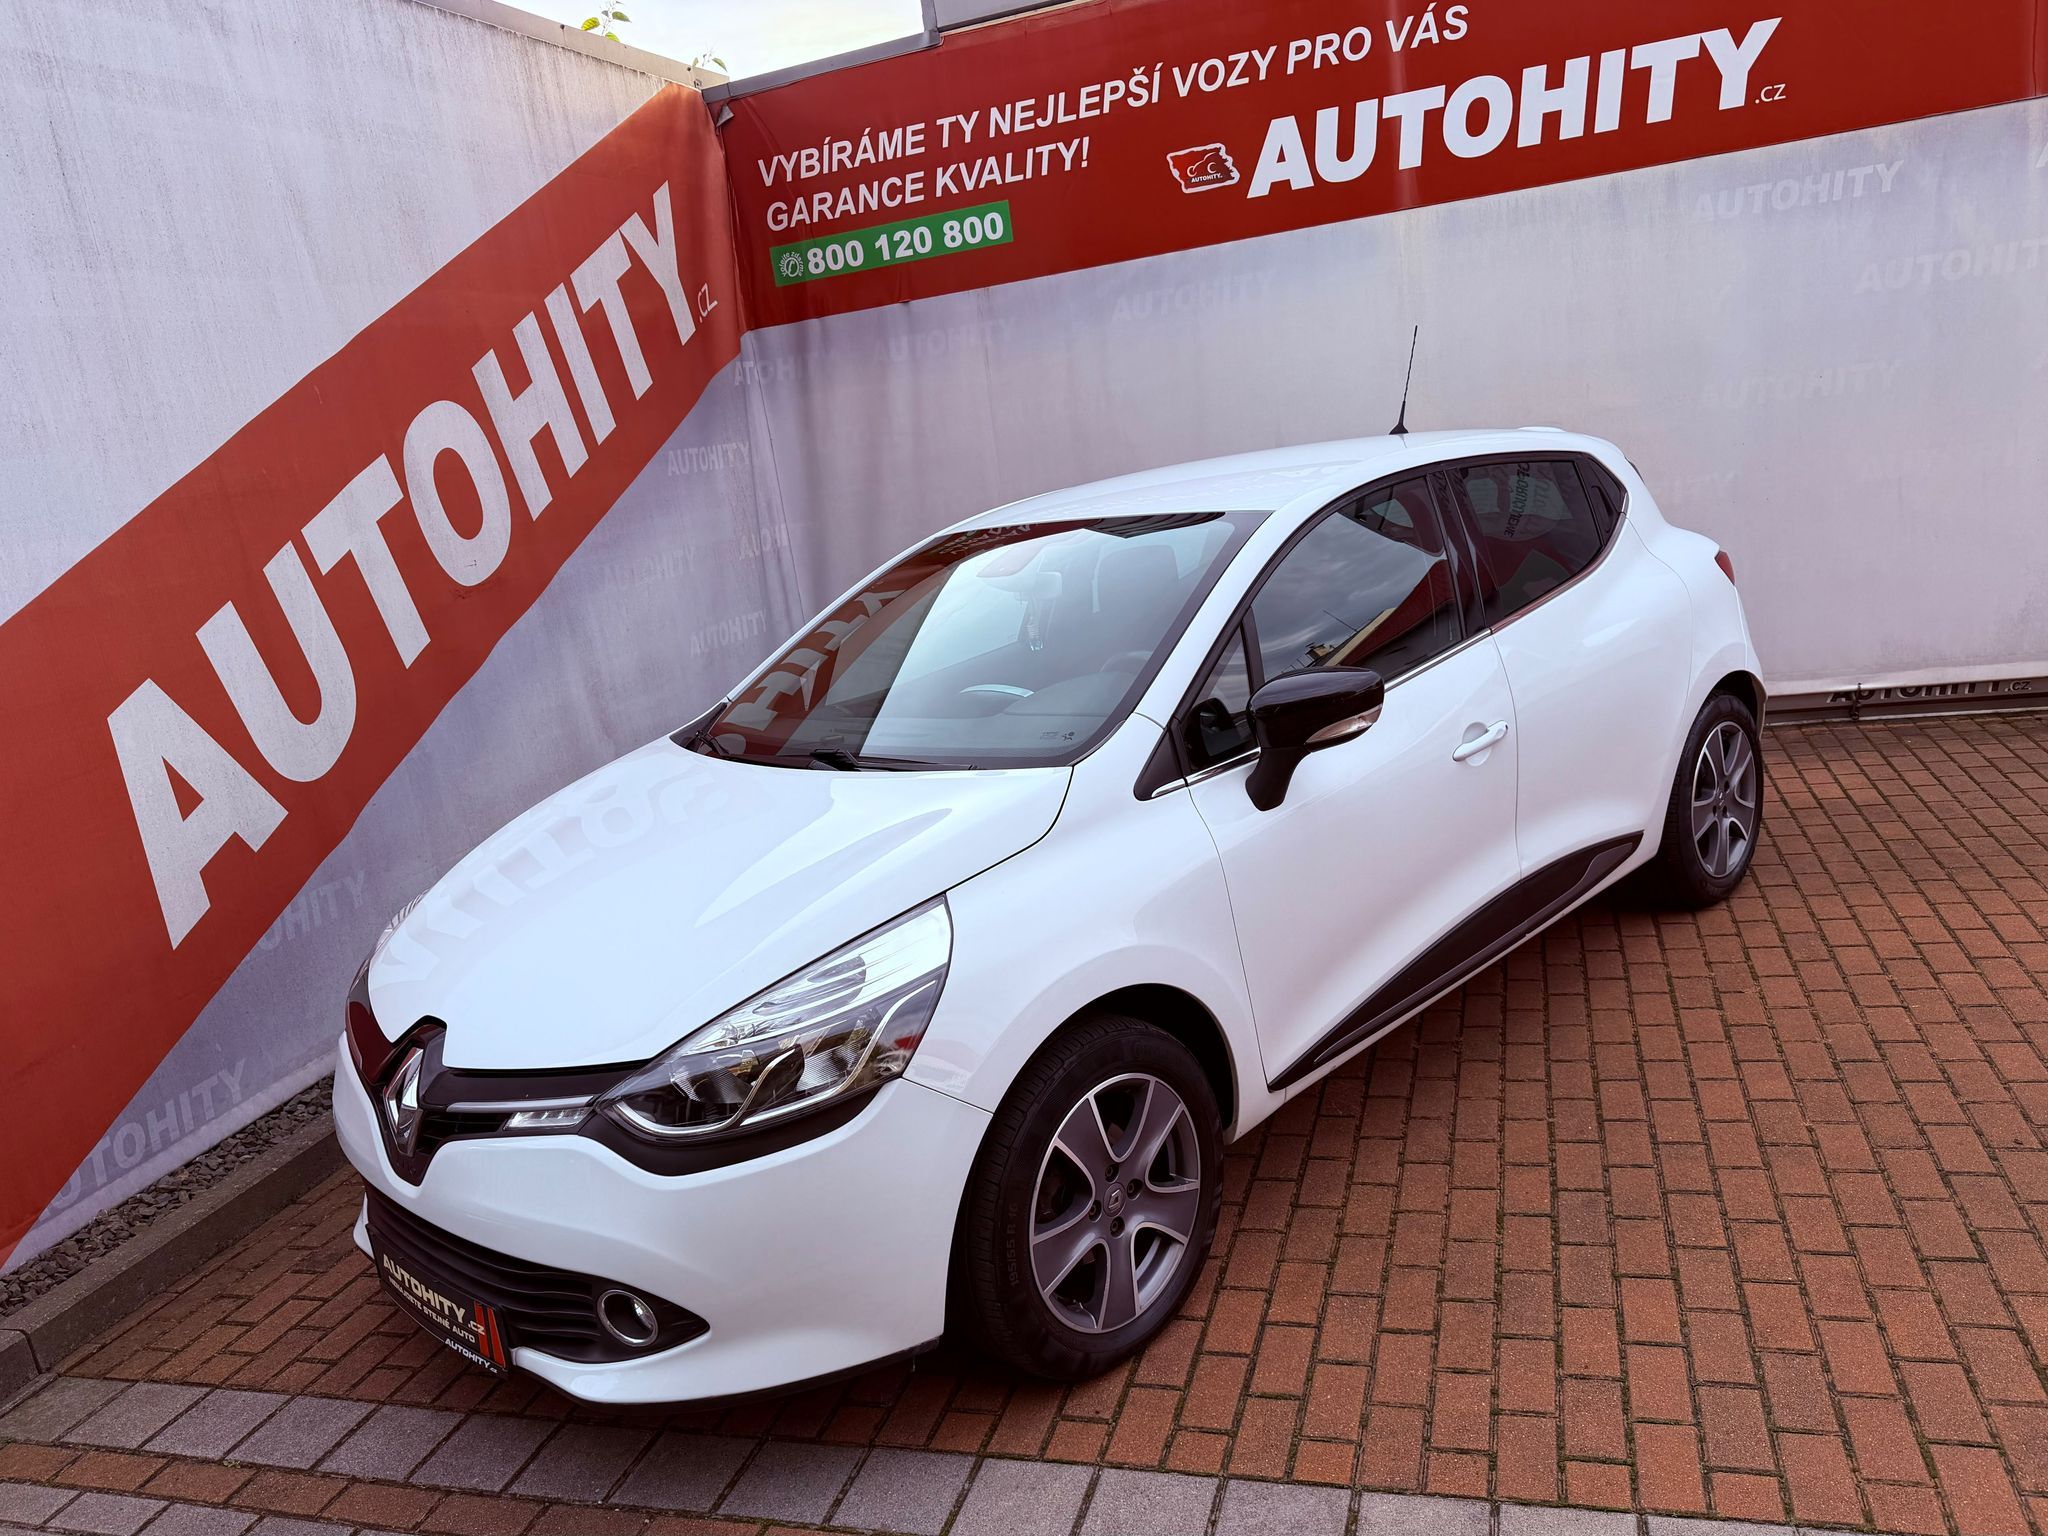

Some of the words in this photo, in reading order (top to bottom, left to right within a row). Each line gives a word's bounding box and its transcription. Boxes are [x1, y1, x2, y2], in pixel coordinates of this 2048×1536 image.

[757, 122, 926, 188] VYBÍRÁME
[936, 110, 980, 149] TY
[989, 62, 1164, 139] NEJLEPŠÍ
[1172, 45, 1278, 98] VOZY
[1286, 26, 1372, 75] PRO
[1385, 4, 1469, 53] VÁS
[766, 170, 925, 232] GARANCE
[935, 136, 1091, 198] KVALITY!
[1696, 159, 1904, 224] AUTOHITY
[807, 240, 865, 275] 800
[874, 226, 933, 262] 120
[942, 212, 1004, 248] 800
[452, 1325, 476, 1344] AUTO
